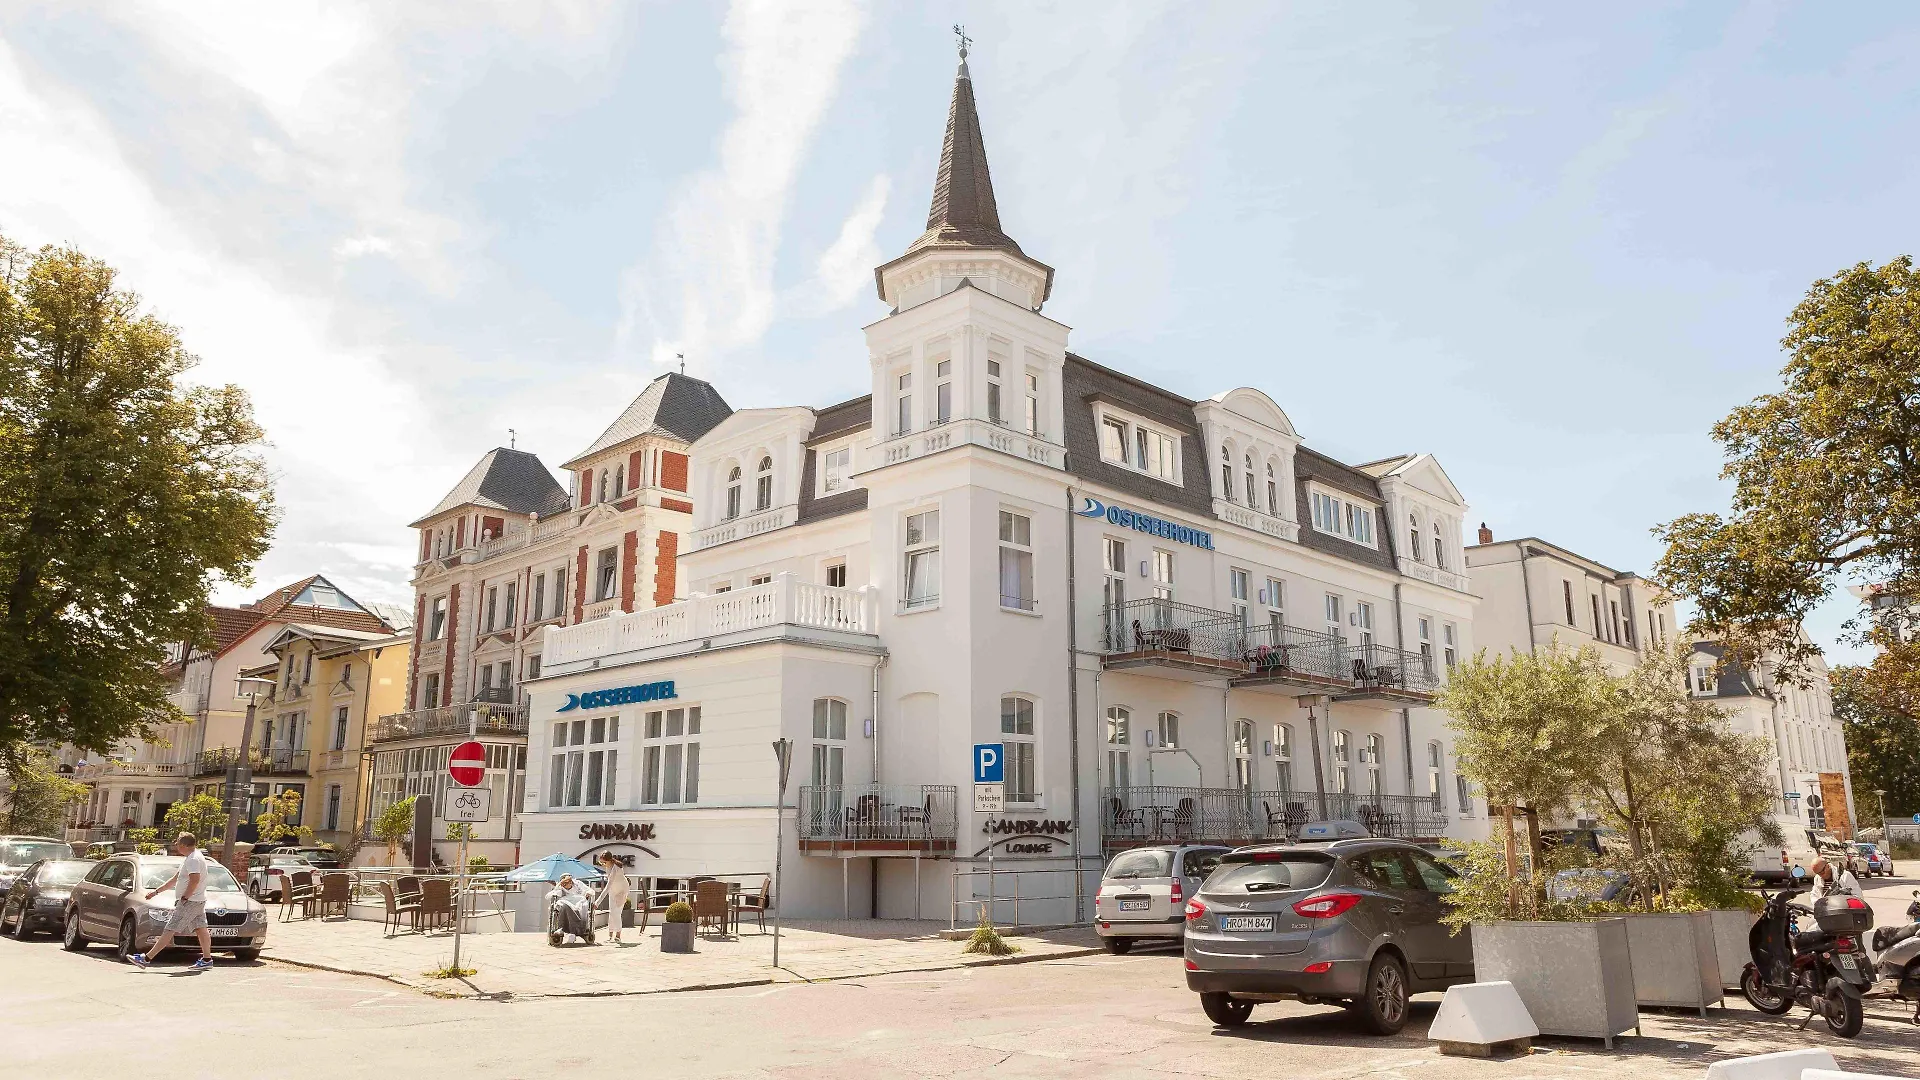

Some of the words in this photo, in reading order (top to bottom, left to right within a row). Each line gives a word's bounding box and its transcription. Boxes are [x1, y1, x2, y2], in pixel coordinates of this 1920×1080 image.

[1106, 505, 1215, 550] OSTSEEHOTEL
[580, 680, 678, 710] OSTSEEHOTEL
[980, 748, 997, 778] P
[460, 810, 475, 818] frei
[578, 823, 656, 841] SANDBANK
[982, 819, 1073, 834] SANDBANK
[1005, 843, 1052, 853] LOUNGE
[1226, 918, 1243, 929] HRO
[1255, 918, 1271, 928] 847
